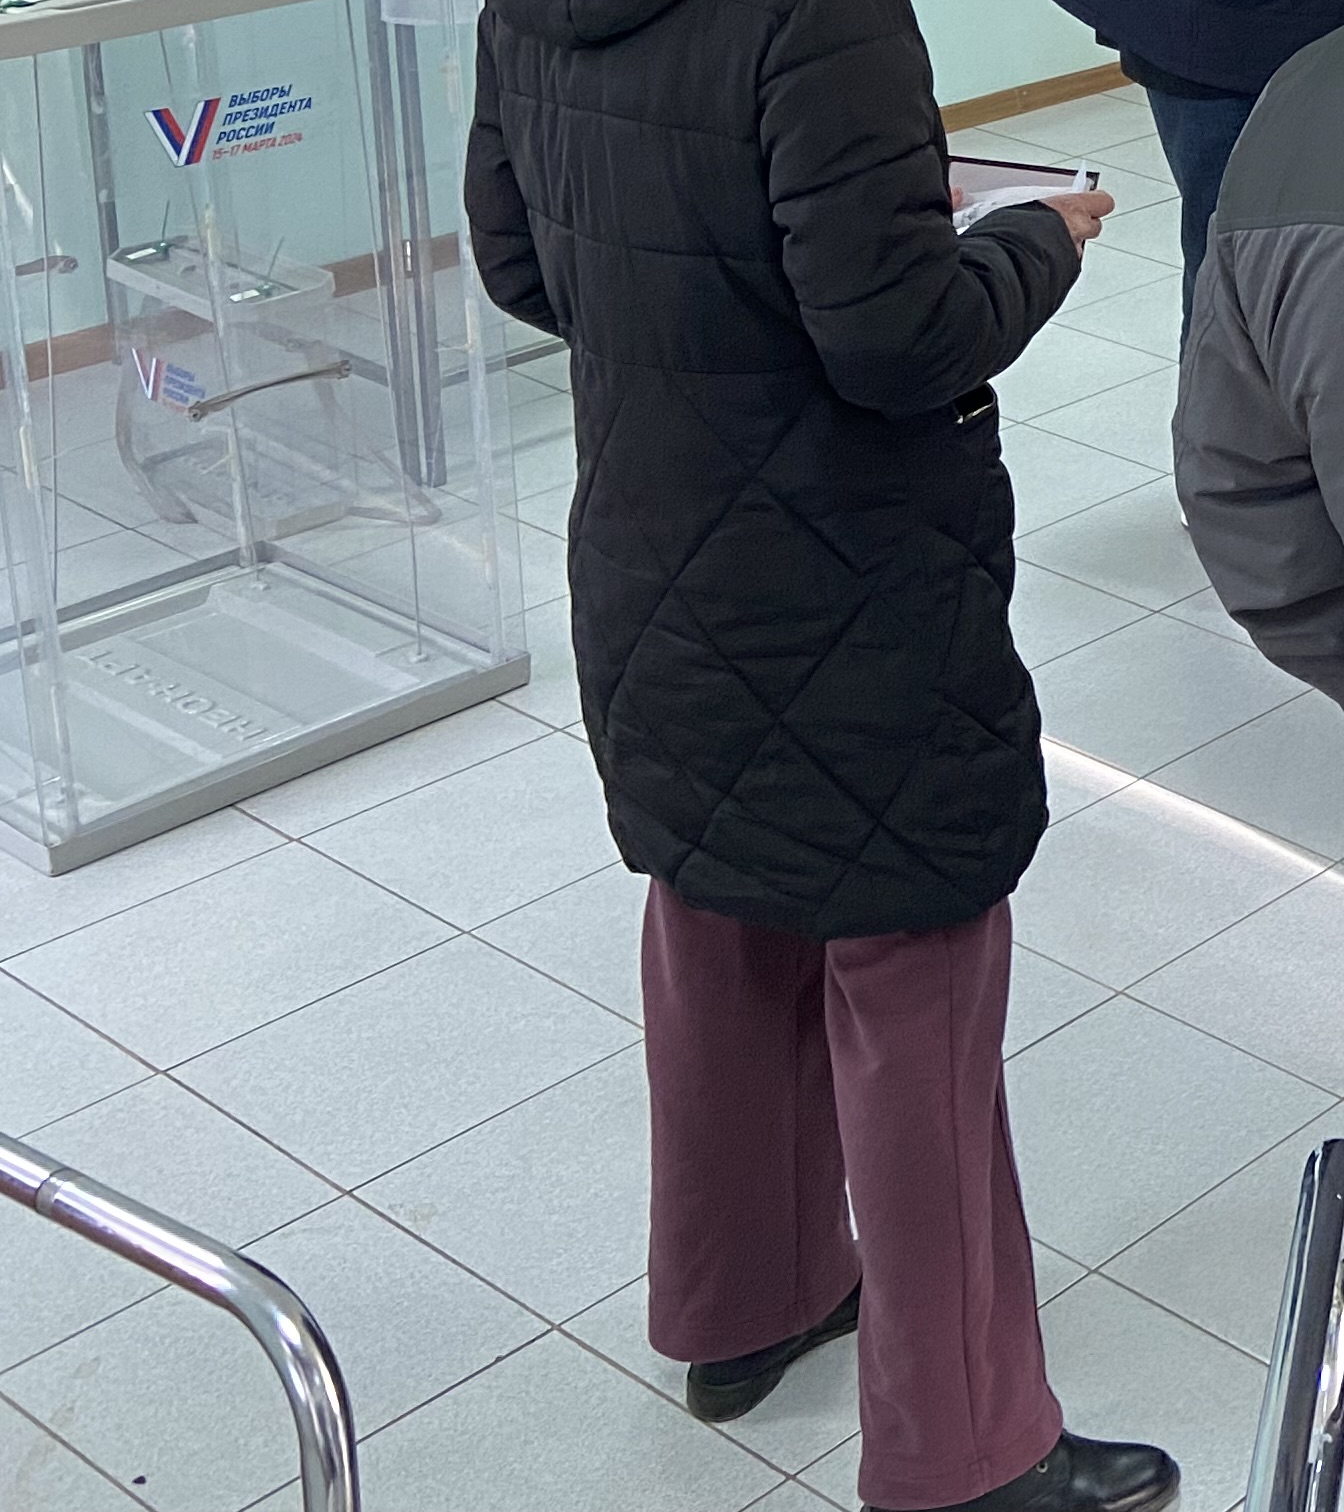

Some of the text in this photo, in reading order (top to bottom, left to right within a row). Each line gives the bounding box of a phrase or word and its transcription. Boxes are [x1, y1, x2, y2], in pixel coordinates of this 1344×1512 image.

[228, 84, 293, 109] ВЫБОРЫ
[222, 96, 313, 127] ПРЕЗИДЕНТА
[216, 121, 276, 145] РОССИИ
[241, 136, 276, 153] МАРТА
